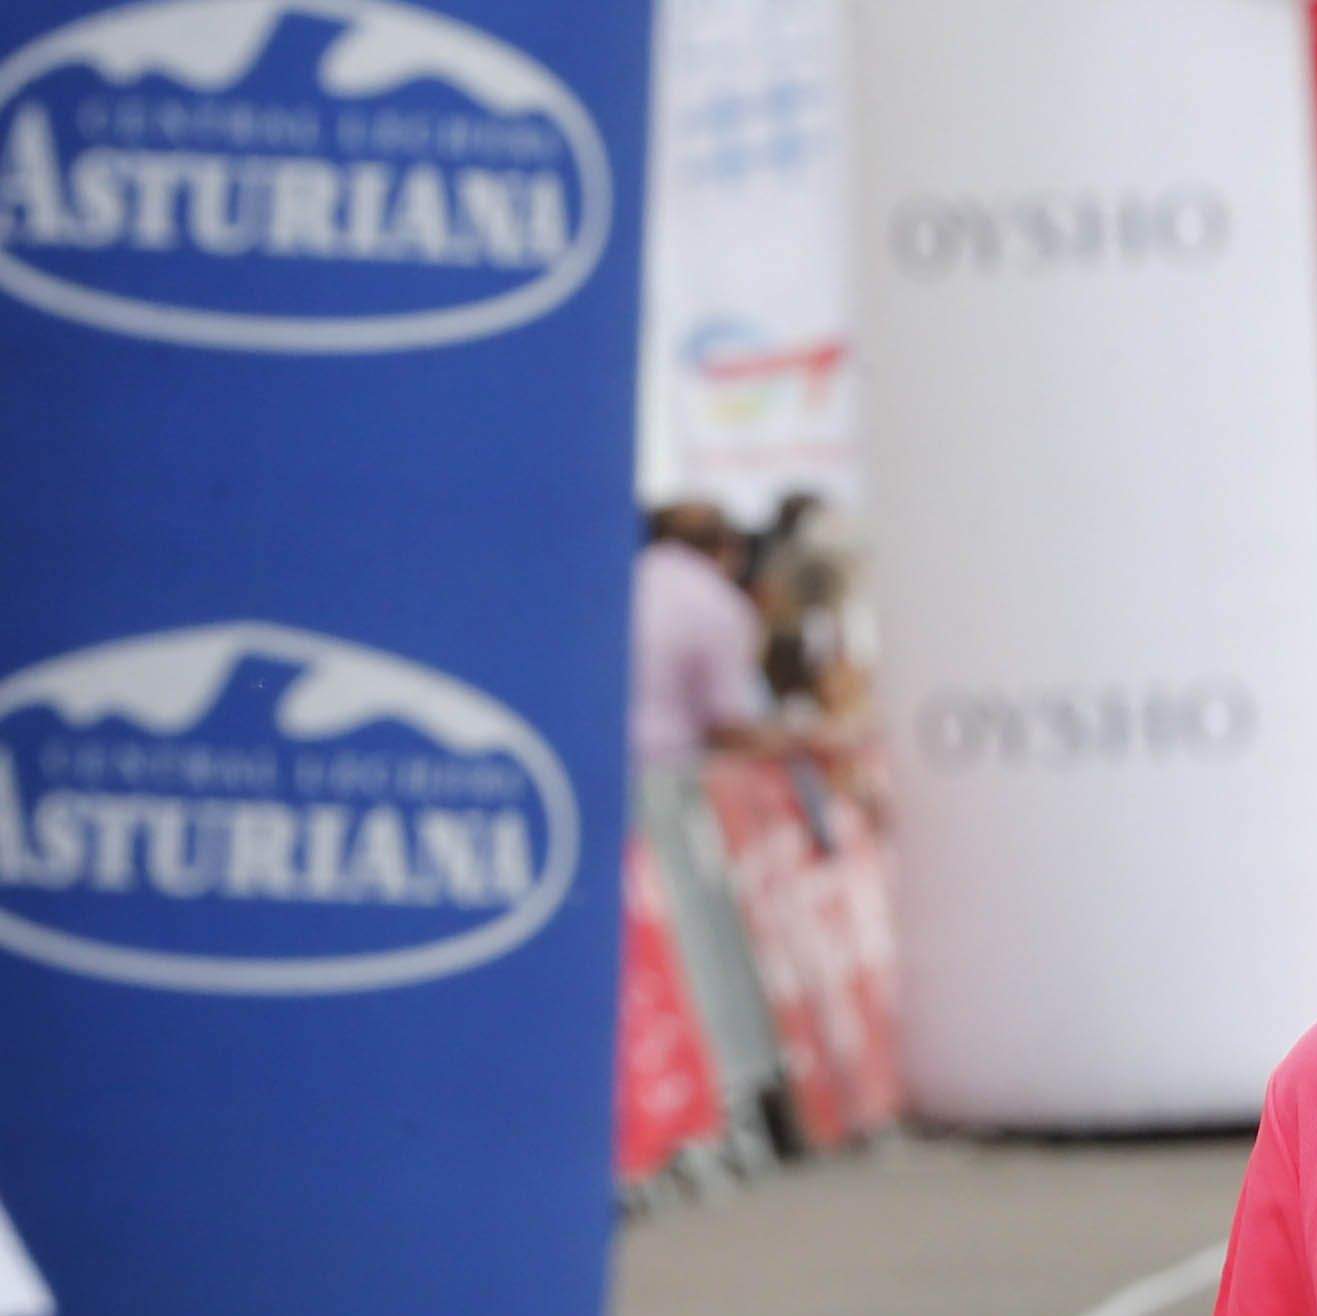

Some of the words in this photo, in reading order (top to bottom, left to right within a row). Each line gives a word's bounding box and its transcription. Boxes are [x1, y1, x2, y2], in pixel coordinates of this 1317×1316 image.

[0, 102, 572, 268] ASTURIANA
[893, 188, 1229, 280] OYSHO
[917, 676, 1256, 772] OYSHO
